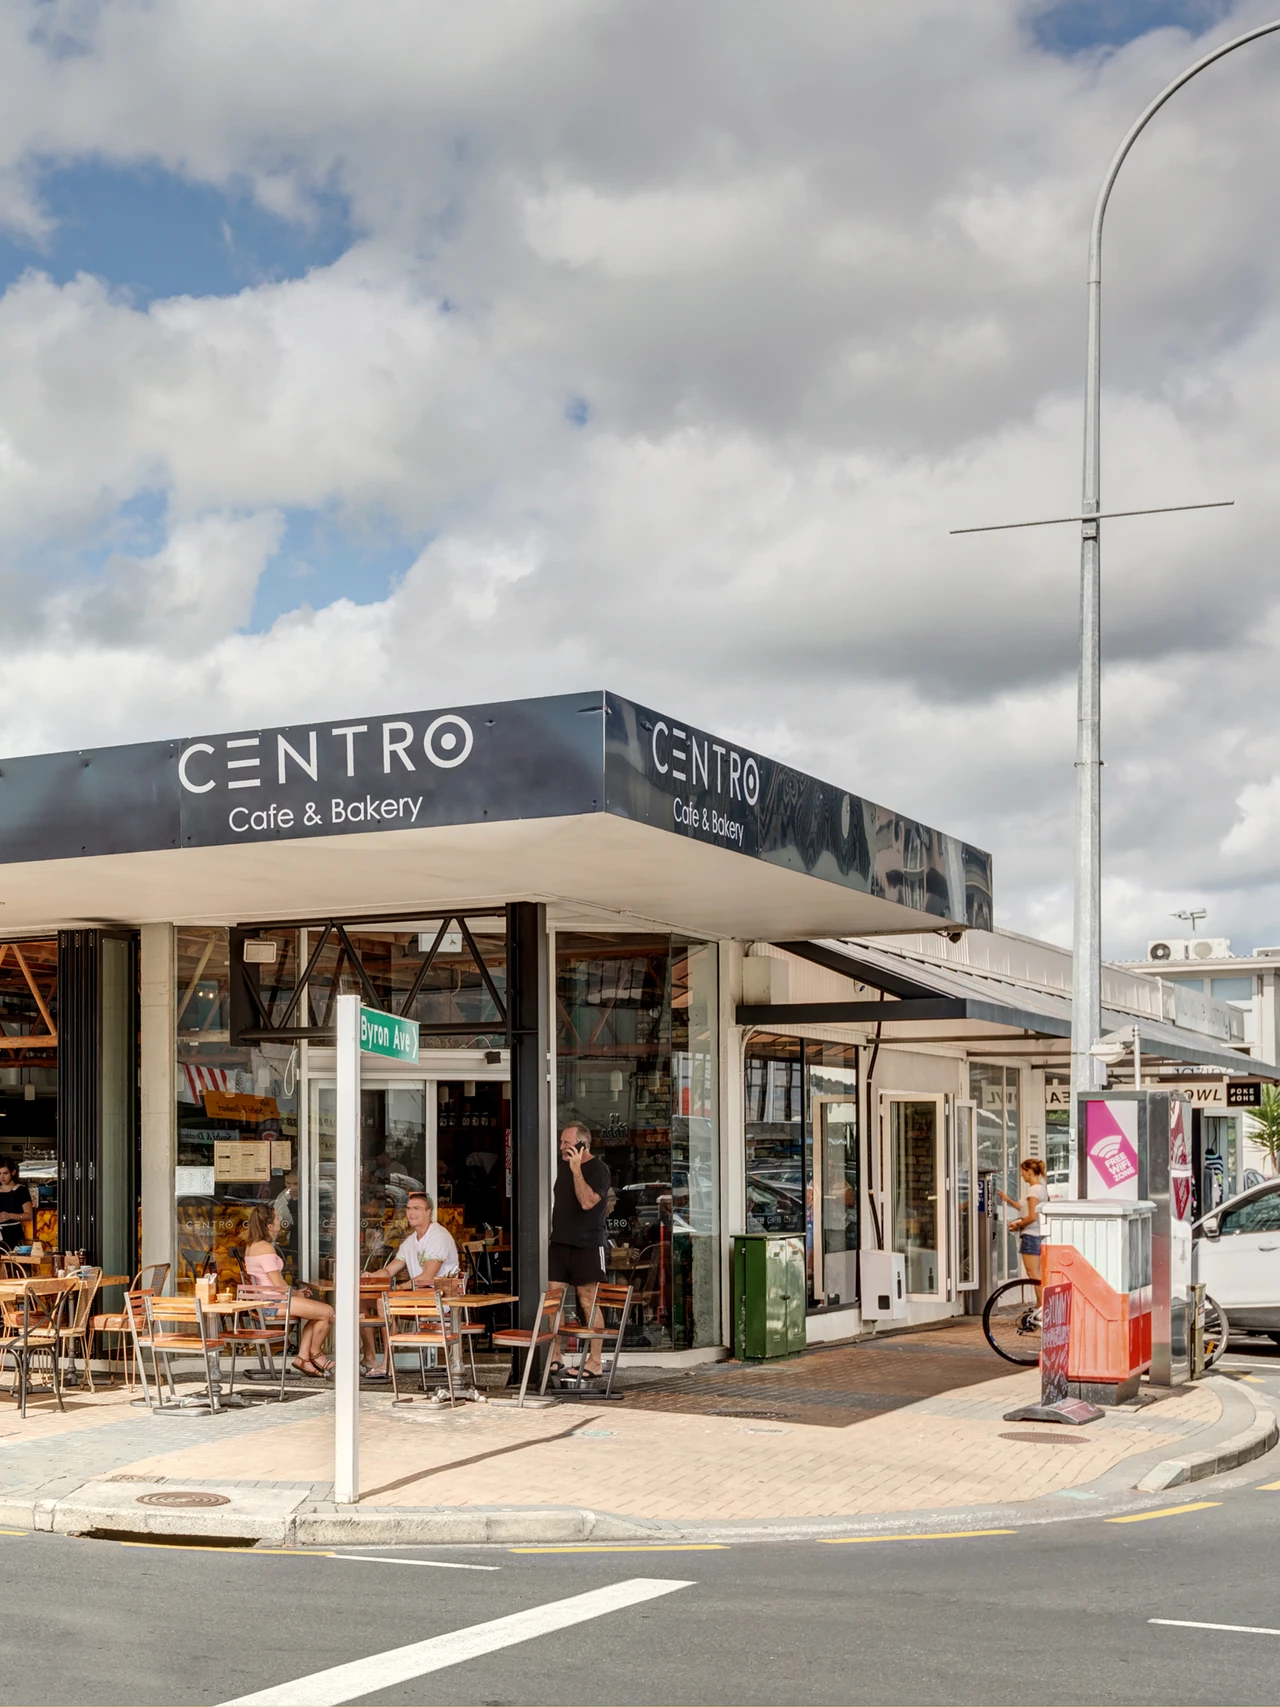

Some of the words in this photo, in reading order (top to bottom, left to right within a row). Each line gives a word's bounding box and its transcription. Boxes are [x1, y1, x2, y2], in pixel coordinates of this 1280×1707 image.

[178, 714, 474, 794] CENTRO
[652, 721, 760, 806] CENTRO
[228, 804, 294, 832] Cafe
[303, 802, 323, 826] &
[331, 795, 423, 823] Bakery
[673, 797, 699, 828] Cafe
[702, 808, 710, 831] &
[712, 810, 744, 847] Bakery
[361, 1014, 389, 1049] Byron
[393, 1024, 410, 1053] Ave
[1230, 1087, 1255, 1095] POKE
[1104, 1152, 1127, 1168] FREE
[1113, 1167, 1136, 1182] ZONE
[186, 1220, 234, 1230] CENTRO
[606, 1218, 628, 1228] TRO
